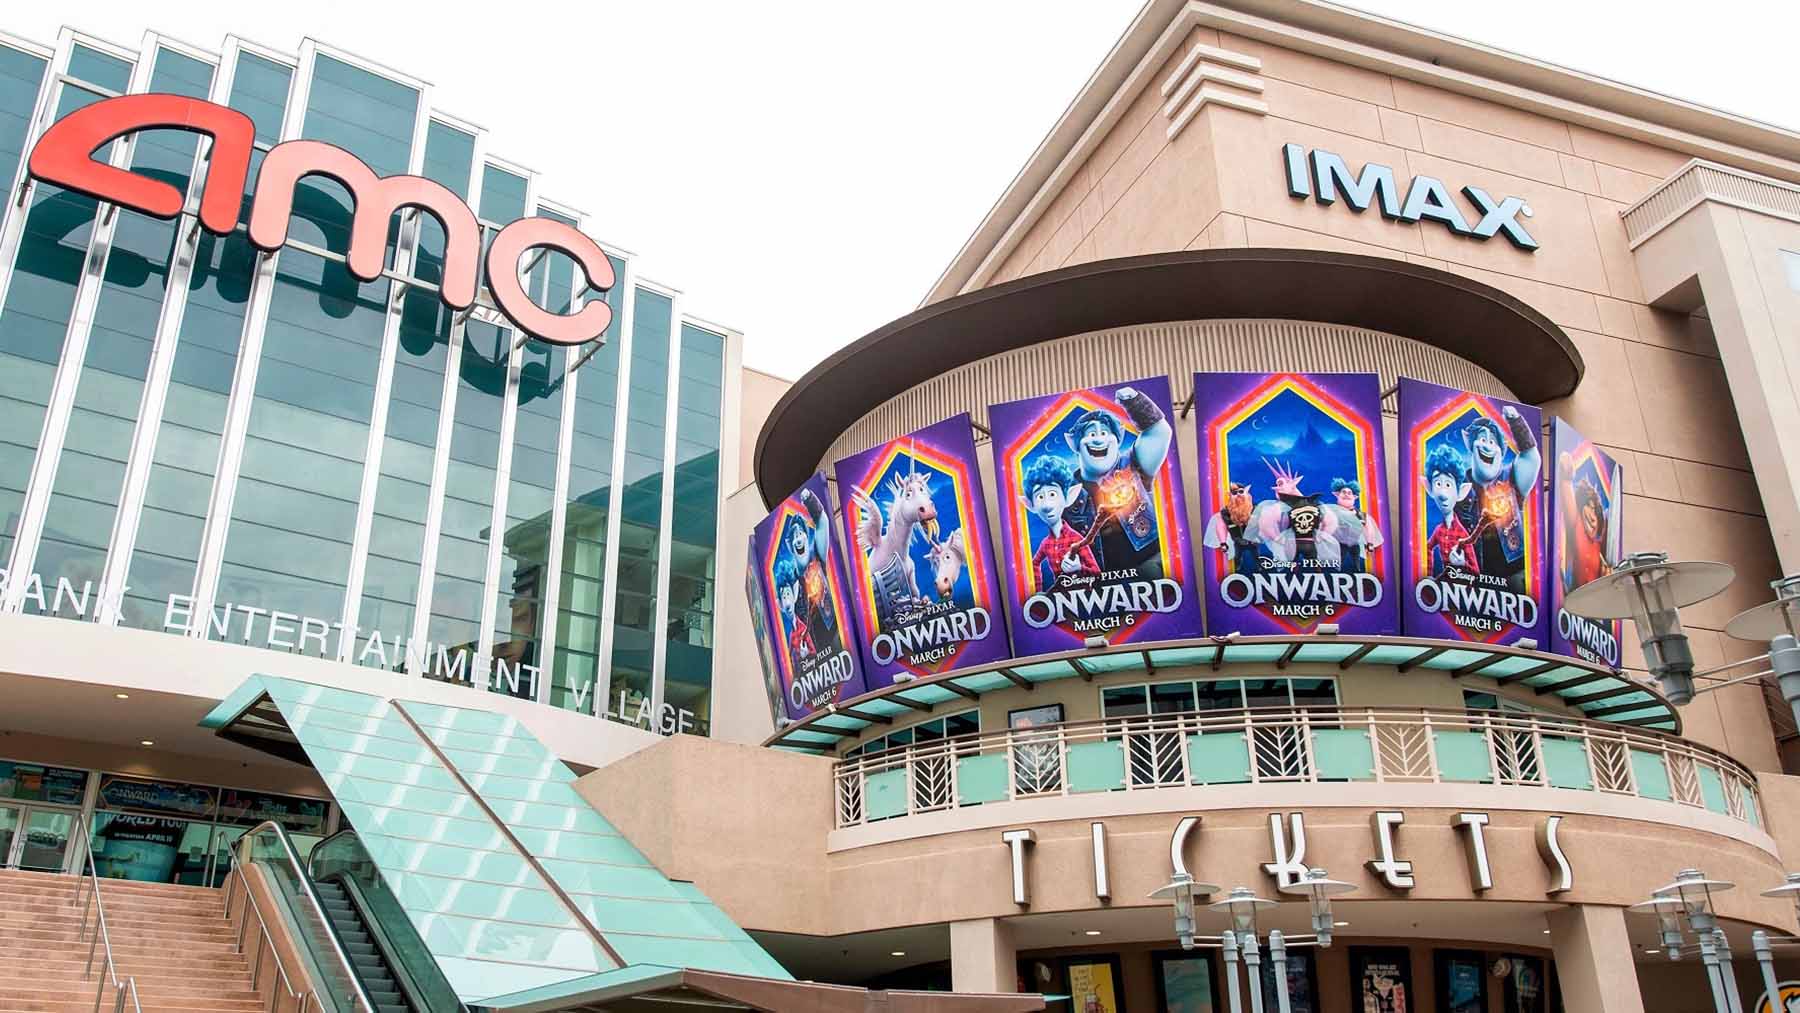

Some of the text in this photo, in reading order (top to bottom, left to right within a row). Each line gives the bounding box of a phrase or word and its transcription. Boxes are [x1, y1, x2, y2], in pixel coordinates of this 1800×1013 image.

[1282, 143, 1540, 252] IMAX
[1258, 556, 1340, 572] Disney PIXAR
[1446, 565, 1508, 587] Disney PIXAR
[1058, 568, 1138, 588] Disney PIXAR
[1220, 573, 1383, 608] ONWARD
[895, 600, 956, 625] Disney PIXAR
[1023, 578, 1183, 629] ONWARD
[1273, 604, 1335, 619] MARCH 6
[1415, 577, 1538, 629] ONWARD
[1074, 614, 1135, 632] MARCH 6
[1455, 614, 1502, 632] MARCH 6
[164, 593, 544, 697] ENTERTAINMENT
[872, 607, 991, 666] ONWARD
[1558, 607, 1618, 666] ONWARD
[817, 646, 833, 661] PIXAR
[910, 644, 956, 666] MARCH 6
[791, 650, 854, 710] ONWARD
[811, 686, 837, 707] MARCH 6
[1002, 811, 1573, 906] TICKETS
